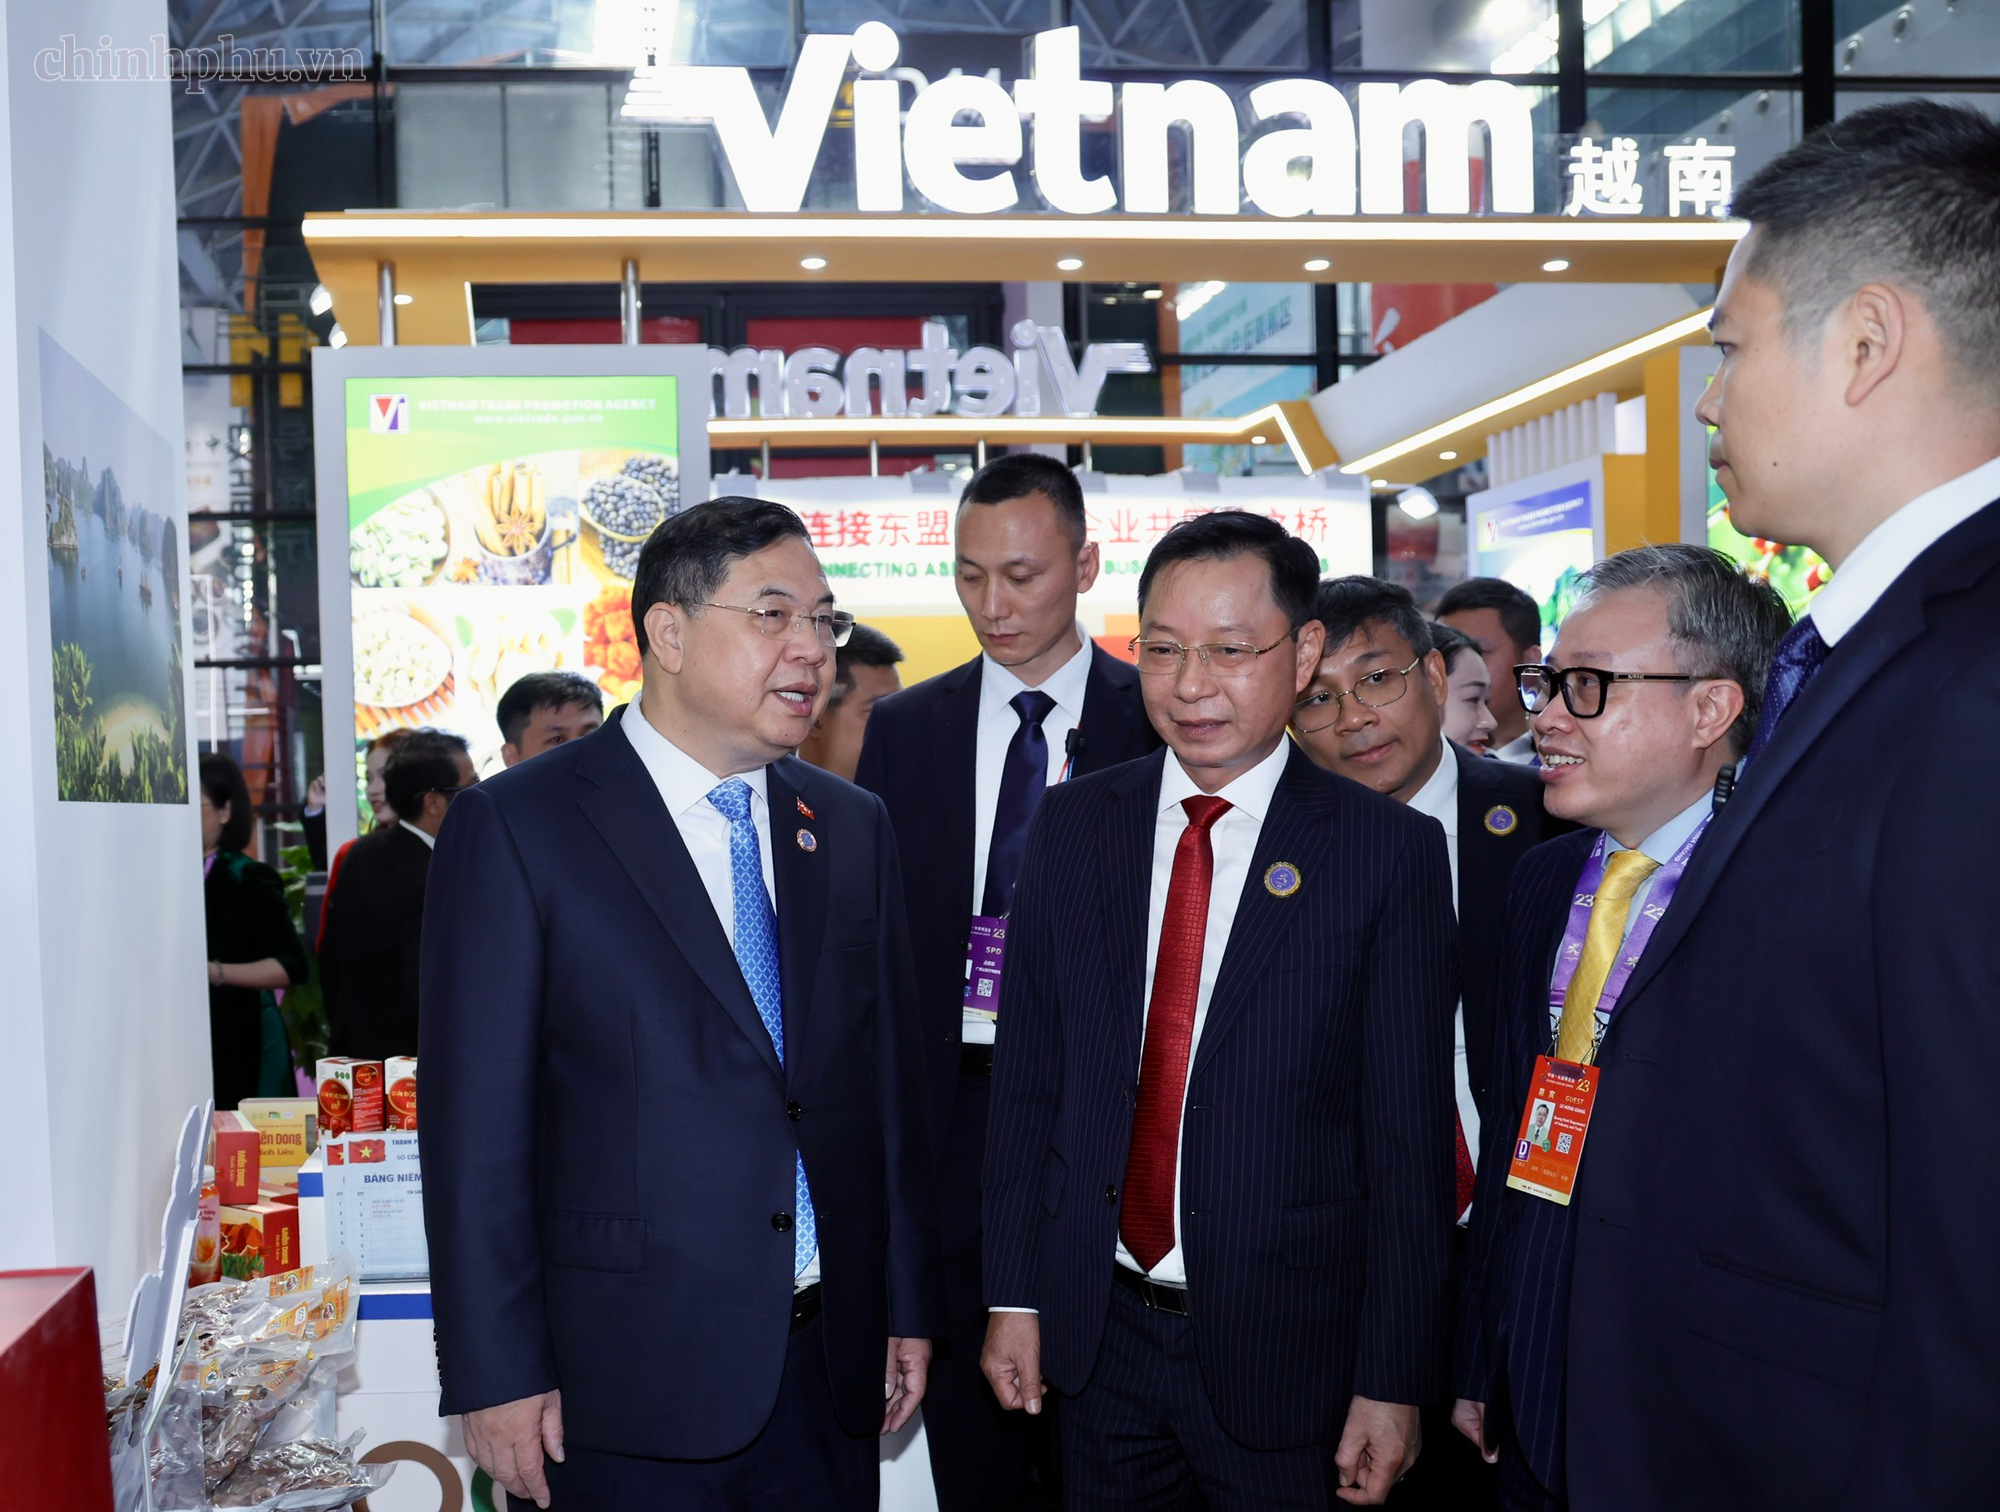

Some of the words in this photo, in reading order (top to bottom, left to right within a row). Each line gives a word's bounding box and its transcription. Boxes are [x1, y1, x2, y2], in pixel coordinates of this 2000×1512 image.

[621, 21, 1535, 217] Vietnam
[1567, 137, 1736, 217] 越南
[418, 400, 477, 411] VIETNAM
[479, 400, 521, 411] TRADE
[523, 400, 603, 411] PROMOTION
[605, 398, 655, 410] AGENCY
[801, 510, 950, 547] 连接东盟
[1573, 893, 1594, 907] 23
[992, 928, 1006, 939] 23
[985, 946, 1002, 955] SPD
[1576, 1078, 1591, 1093] 23
[1565, 1095, 1584, 1105] GUEST
[275, 1133, 302, 1146] Dong
[1518, 1140, 1528, 1156] D
